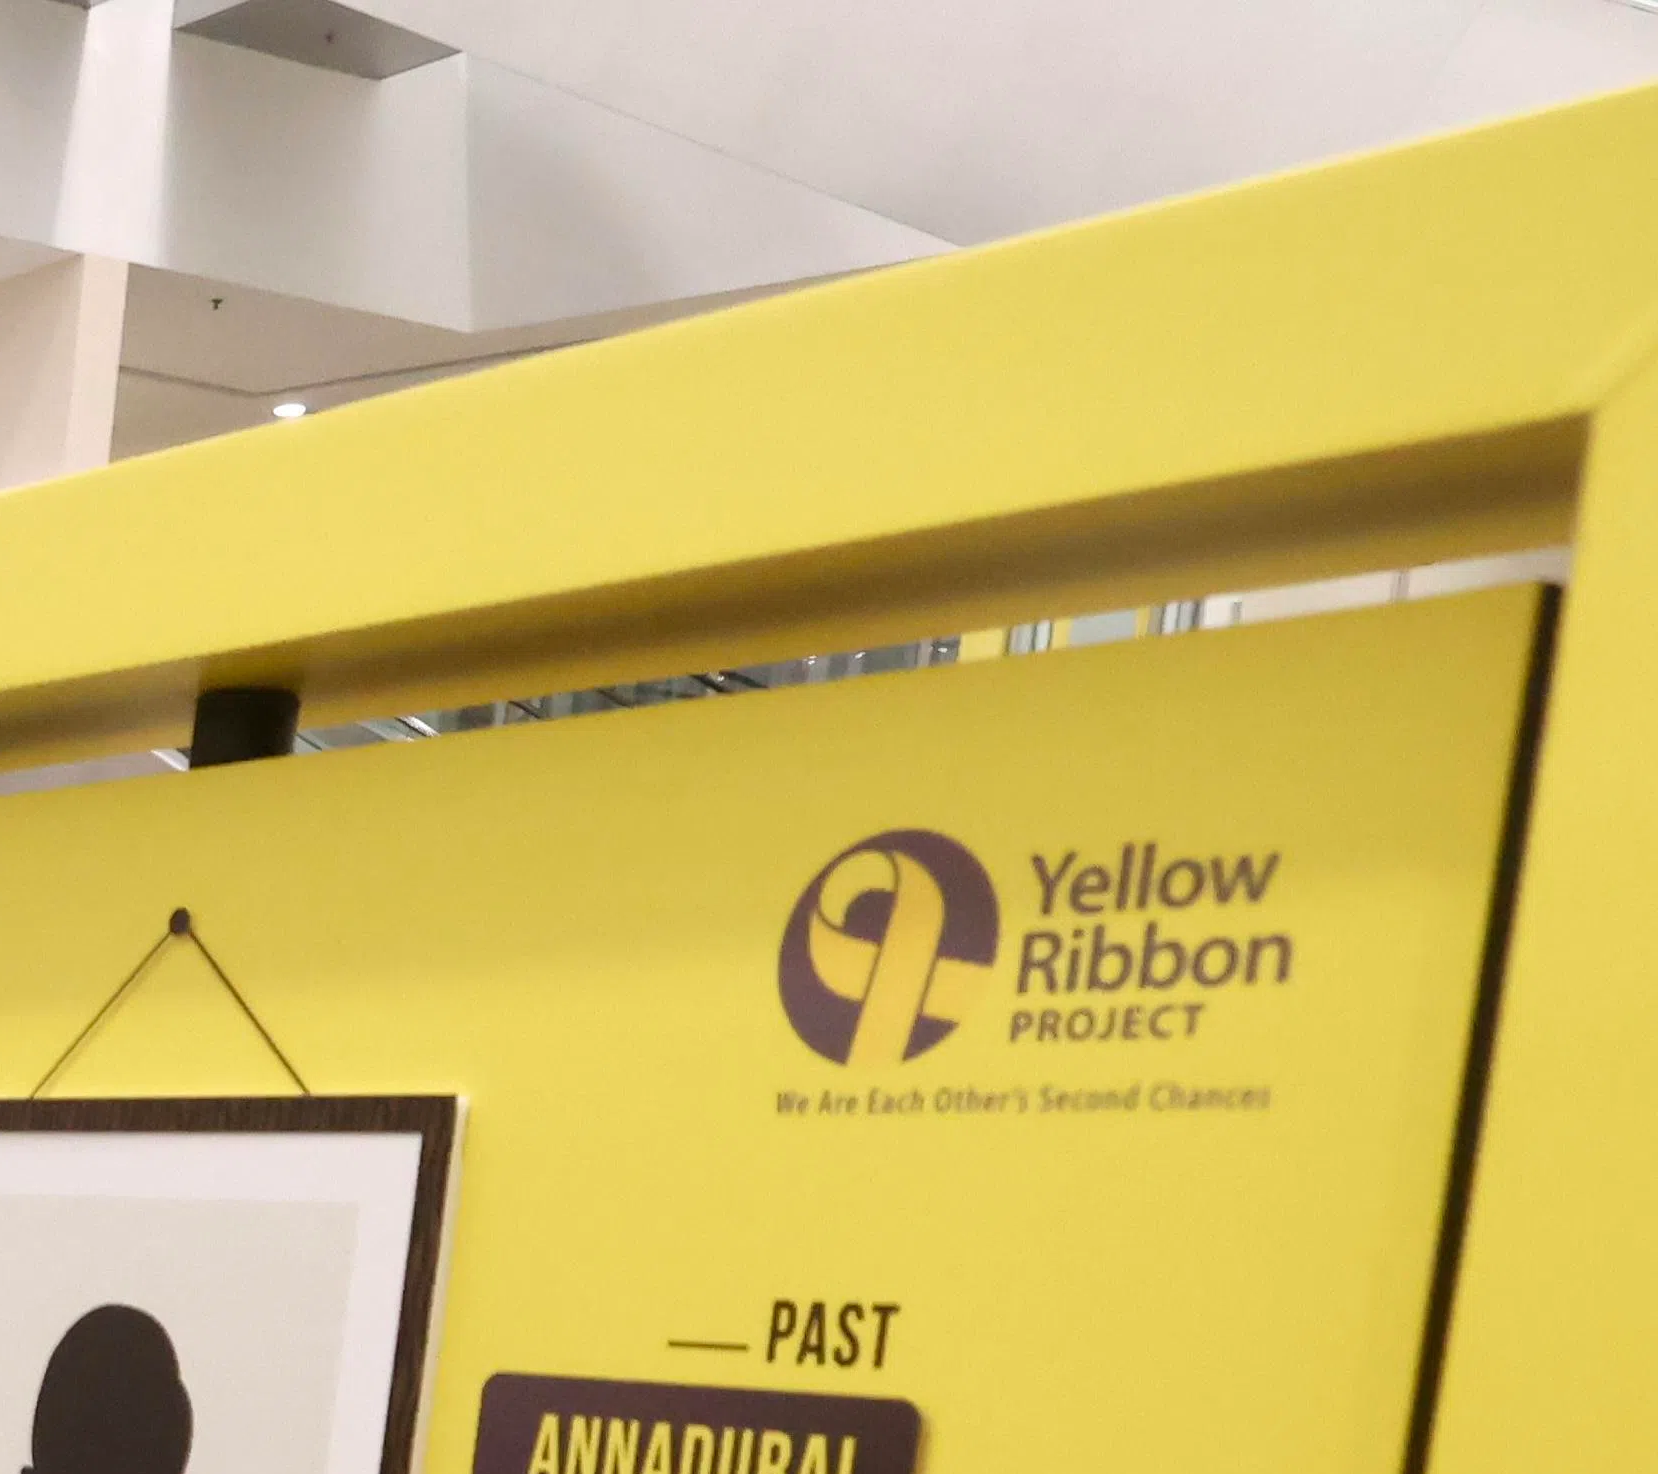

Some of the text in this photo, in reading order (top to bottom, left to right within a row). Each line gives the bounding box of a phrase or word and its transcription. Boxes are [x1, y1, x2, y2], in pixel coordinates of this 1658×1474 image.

[1029, 842, 1282, 921] Yellow
[1015, 919, 1292, 996] Ribbon
[1008, 1003, 1205, 1045] PROJECT
[775, 1089, 809, 1116] We
[817, 1088, 858, 1116] Are
[867, 1086, 925, 1115] Each
[1039, 1082, 1138, 1114] Second
[1147, 1080, 1272, 1113] Chances
[766, 1299, 901, 1369] PAST
